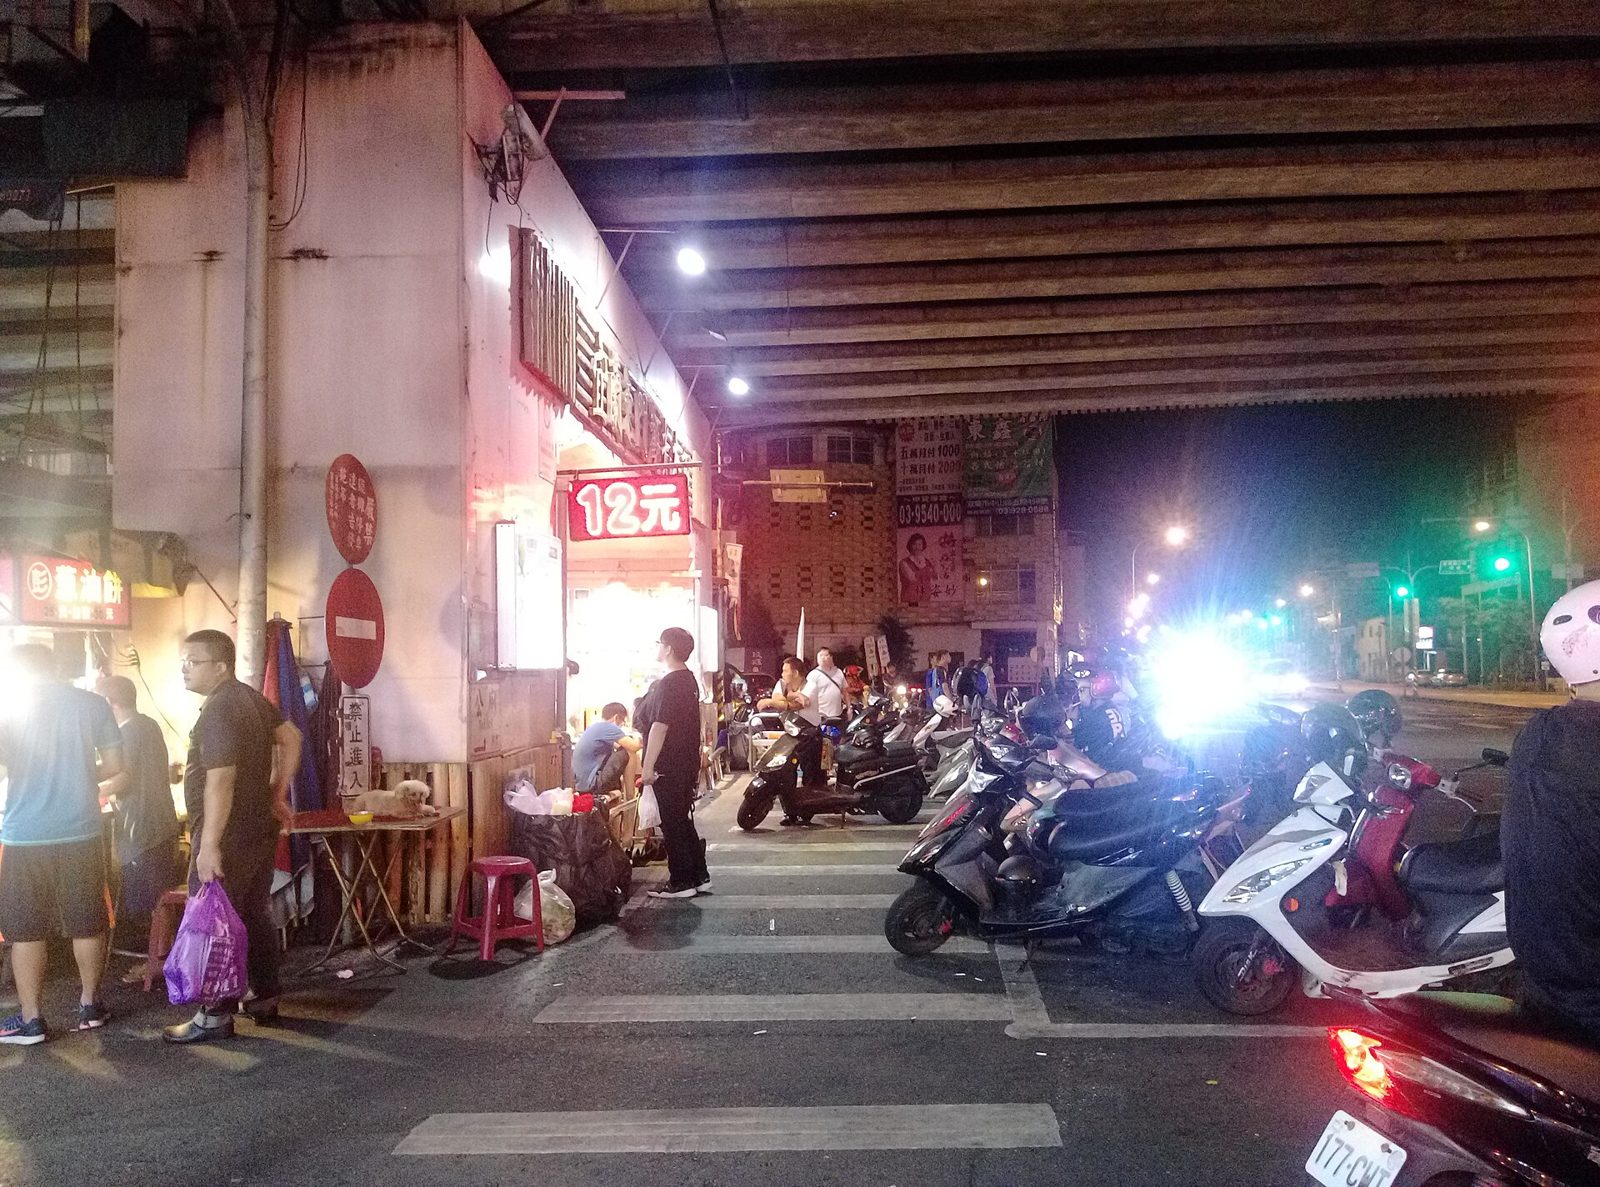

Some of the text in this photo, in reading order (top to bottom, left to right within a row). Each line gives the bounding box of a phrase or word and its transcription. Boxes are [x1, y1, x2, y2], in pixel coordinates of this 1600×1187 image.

[938, 444, 961, 459] 1000
[576, 482, 681, 536] 12元
[348, 702, 363, 790] 禁止進入
